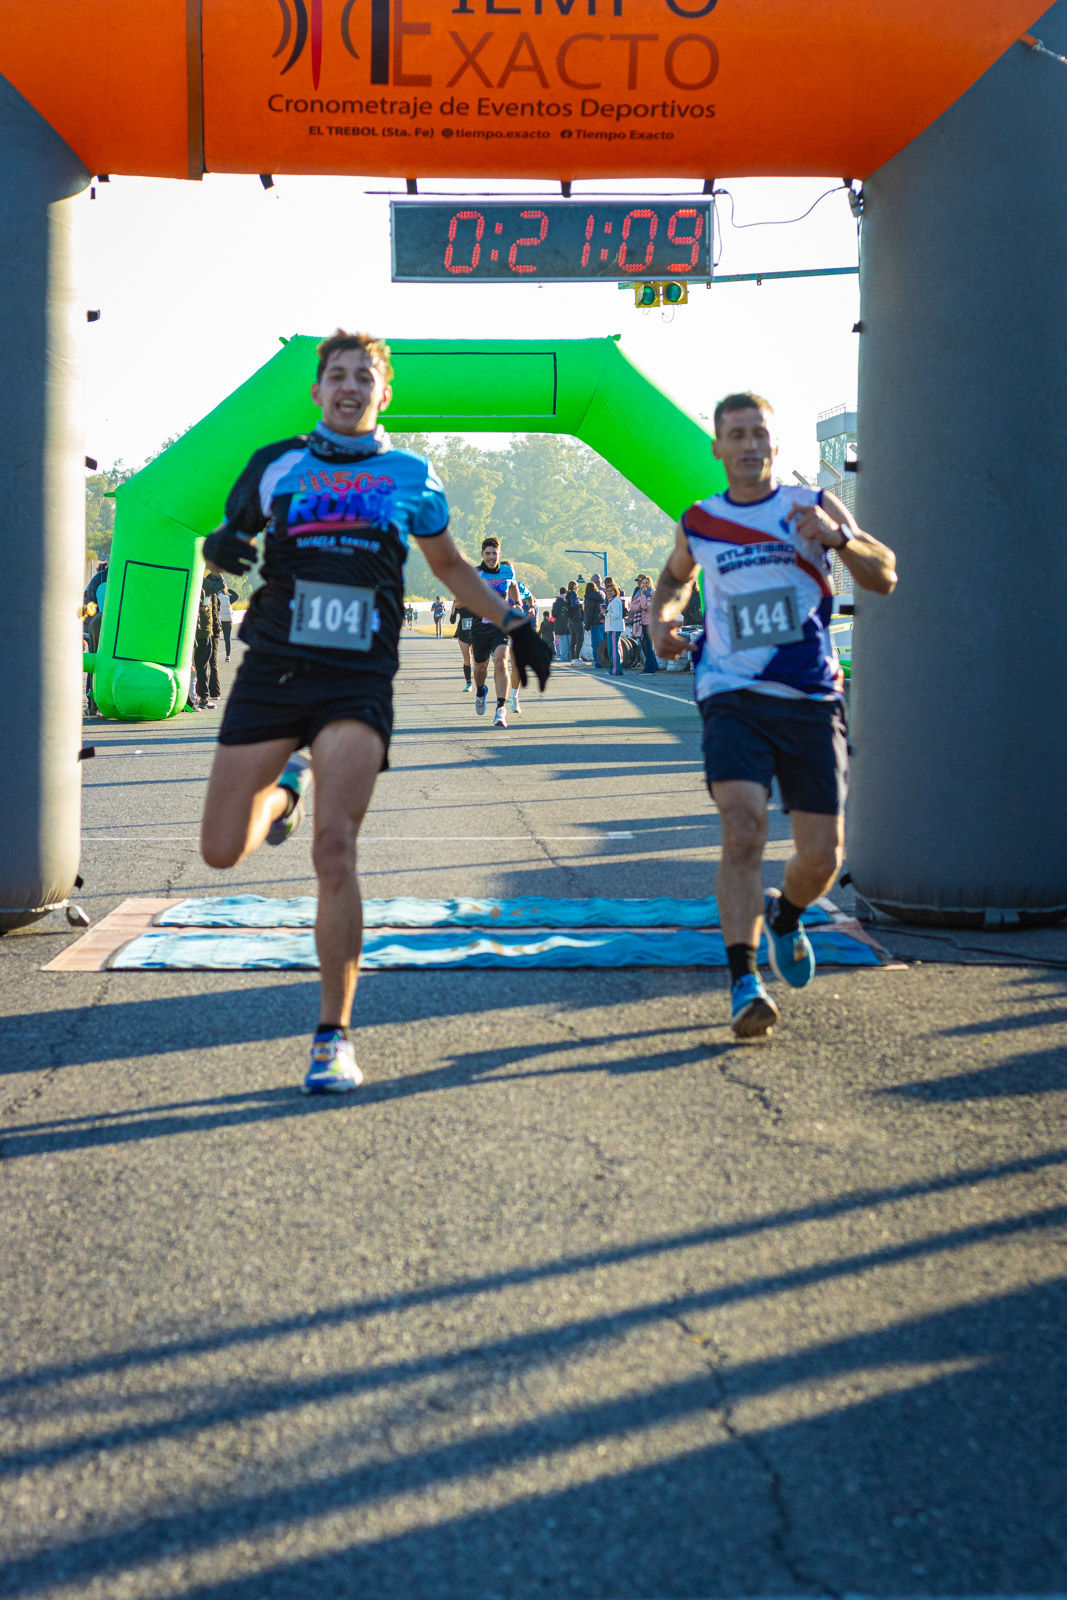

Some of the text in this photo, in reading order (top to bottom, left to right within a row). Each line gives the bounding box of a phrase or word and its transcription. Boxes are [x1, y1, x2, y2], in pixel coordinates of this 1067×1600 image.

[392, 0, 720, 91] EXACTO
[267, 93, 716, 121] Cronometraje de Eventos Deportivos
[308, 125, 674, 142] EL TREBOL (Sta. Fe) tiempo.exacto Tiempo Exacto
[287, 492, 388, 525] RUN
[307, 595, 361, 635] 104
[739, 600, 789, 637] 144
